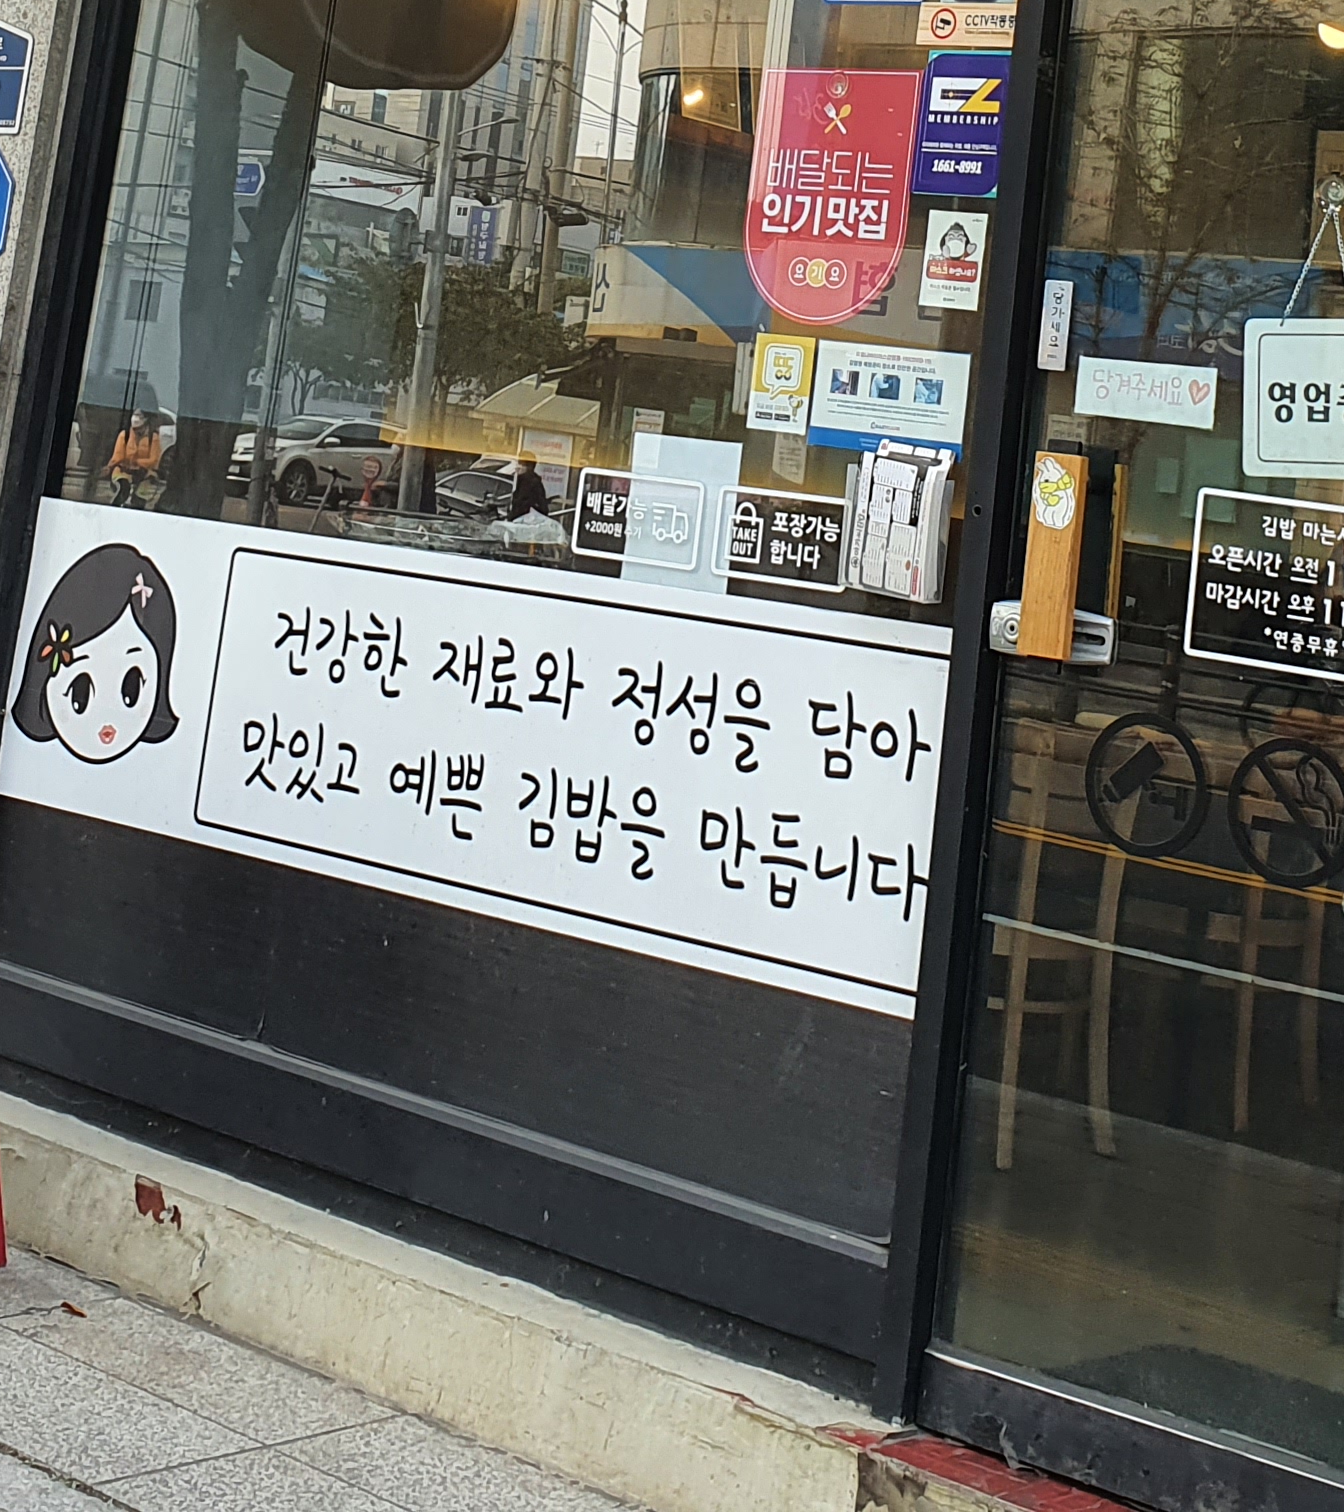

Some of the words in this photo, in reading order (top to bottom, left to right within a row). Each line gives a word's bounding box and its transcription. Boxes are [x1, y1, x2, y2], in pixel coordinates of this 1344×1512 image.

[927, 114, 999, 125] MEMBERSHIP
[766, 149, 894, 195] 배달되는
[931, 159, 983, 175] 1661-8991
[761, 194, 890, 242] 인기맛집
[788, 256, 848, 289] 요기요
[1092, 368, 1184, 407] 당겨주세요
[586, 491, 648, 520] 배달가능
[584, 520, 623, 538] +2000원
[731, 525, 758, 543] TAKE
[771, 511, 841, 544] 포장가능
[1262, 515, 1297, 541] 김밥
[731, 540, 754, 557] OUT
[769, 538, 821, 570] 합니다
[1207, 544, 1283, 578] 오픈시간
[1290, 555, 1320, 579] 오전
[1205, 582, 1281, 616] 마감시간
[1287, 593, 1316, 615] 오후
[274, 606, 408, 700] 건강한
[432, 634, 584, 720] 재료와
[612, 660, 771, 775] 정성을
[809, 692, 932, 783] 담아
[243, 713, 362, 804] 맛있고
[389, 749, 486, 841] 예쁜
[519, 767, 666, 881] 김밥을
[700, 805, 929, 922] 만듭니다
